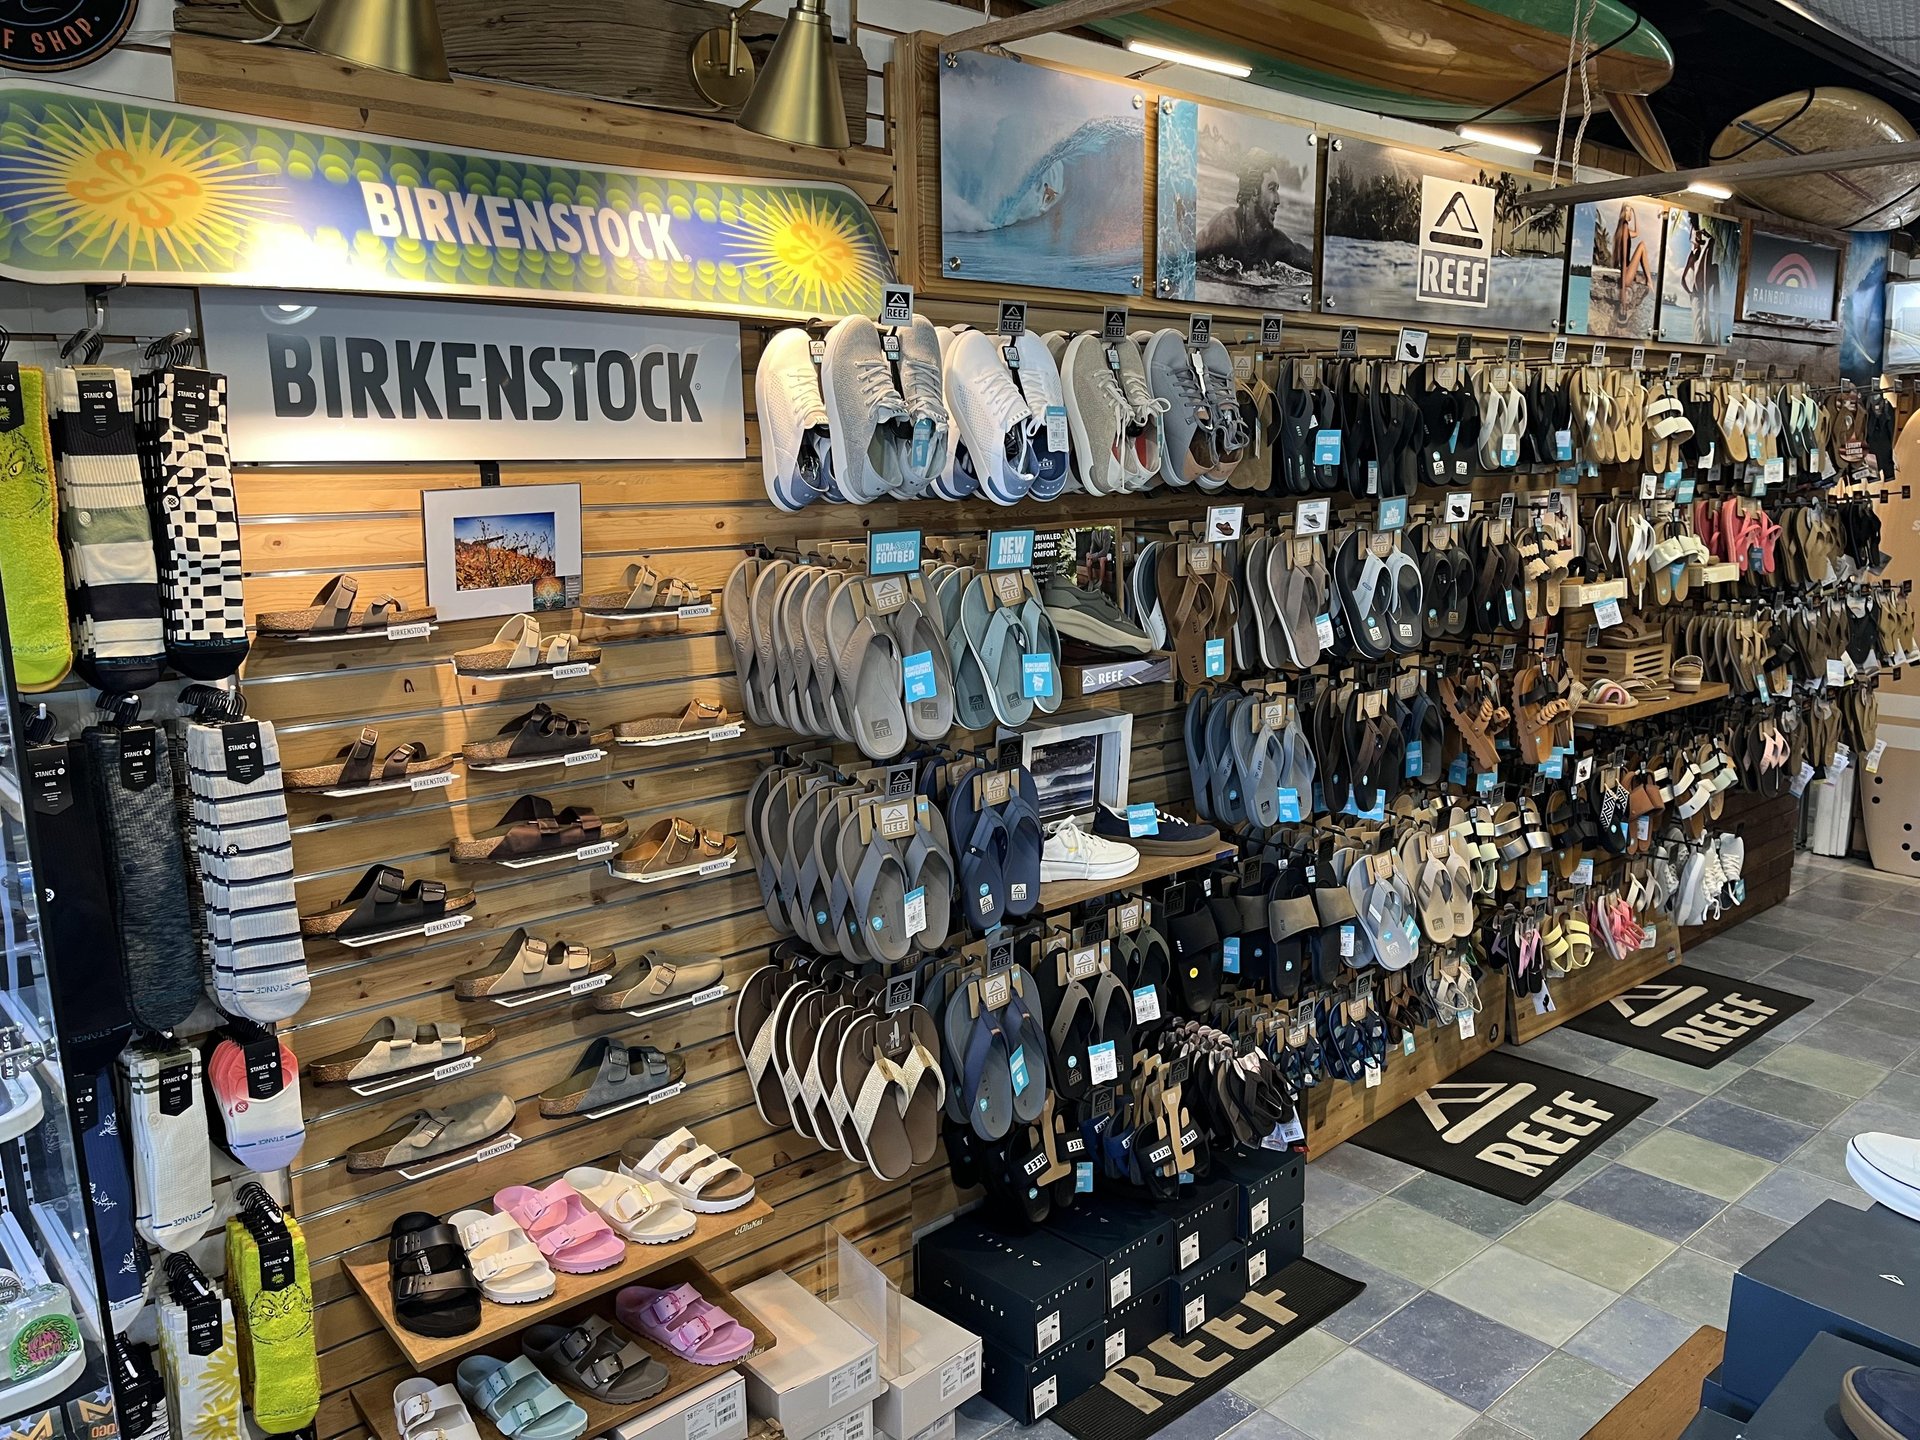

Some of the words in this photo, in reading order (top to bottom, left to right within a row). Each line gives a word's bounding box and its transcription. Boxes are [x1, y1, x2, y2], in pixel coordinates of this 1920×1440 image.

[31, 17, 94, 54] SHOP
[360, 180, 684, 263] BIRKENSTOCK
[1422, 255, 1486, 297] REEF
[1753, 287, 1791, 305] RAINBOW
[887, 308, 909, 318] REEF
[1001, 321, 1023, 331] REEF
[1106, 326, 1124, 336] REEF
[1192, 333, 1208, 342] REEF
[1264, 332, 1279, 341] REEF
[1341, 342, 1356, 350] REEF
[267, 332, 703, 422] BIRKENSTOCK
[177, 390, 197, 399] STANCE
[999, 535, 1027, 554] NEW
[875, 549, 915, 564] FOOTBED
[997, 552, 1025, 565] ARRIVAL
[1033, 549, 1058, 559] OMFORT
[1192, 560, 1209, 570] REEF
[1001, 587, 1021, 601] REEF
[877, 593, 905, 610] REEF
[680, 606, 710, 617] BIRKENSTOCK
[390, 627, 429, 638] BIRKENSTOCK
[194, 638, 232, 648] STANCE
[554, 666, 589, 677] BIRKENSTOCK
[1098, 669, 1124, 685] REEF
[710, 728, 741, 741] BIRKENSTOCK
[874, 727, 891, 739] REEF
[228, 743, 248, 752] STANCE
[124, 749, 143, 759] STANCE
[566, 752, 599, 764] BIRKENSTOCK
[35, 769, 57, 779] STANCE
[412, 776, 450, 789] BIRKENSTOCK
[890, 783, 912, 794] REEF
[988, 789, 1006, 801] REEF
[883, 821, 909, 835] REEF
[579, 845, 612, 857] BIRKENSTOCK
[701, 860, 729, 873] BIRKENSTOCK
[426, 918, 463, 934] BIRKENSTOCK
[1122, 919, 1138, 930] REEF
[991, 958, 1011, 970] REEF
[1074, 963, 1094, 977] REEF
[255, 983, 291, 995] STANCE
[572, 978, 604, 992] BIRKENSTOCK
[694, 988, 723, 1003] BIRKENSTOCK
[890, 992, 911, 1006] REEF
[988, 992, 1007, 1005] REEF
[1660, 991, 1779, 1053] REEF
[250, 1063, 269, 1073] STANCE
[435, 1061, 472, 1078] BIRKENSTOCK
[162, 1075, 181, 1085] STANCE
[650, 1086, 679, 1101] BIRKENSTOCK
[1475, 1090, 1615, 1178] REEF
[258, 1135, 285, 1146] STANCE
[479, 1142, 513, 1159] BIRKENSTOCK
[1151, 1145, 1171, 1162] REEF
[1026, 1153, 1047, 1174] REEF
[173, 1211, 202, 1227] STANCE
[263, 1258, 283, 1268] STANCE
[191, 1322, 211, 1332] STANCE
[1099, 1288, 1299, 1416] REEF
[831, 1375, 837, 1383] 39
[687, 1412, 694, 1421] 38
[820, 1429, 827, 1438] 39
